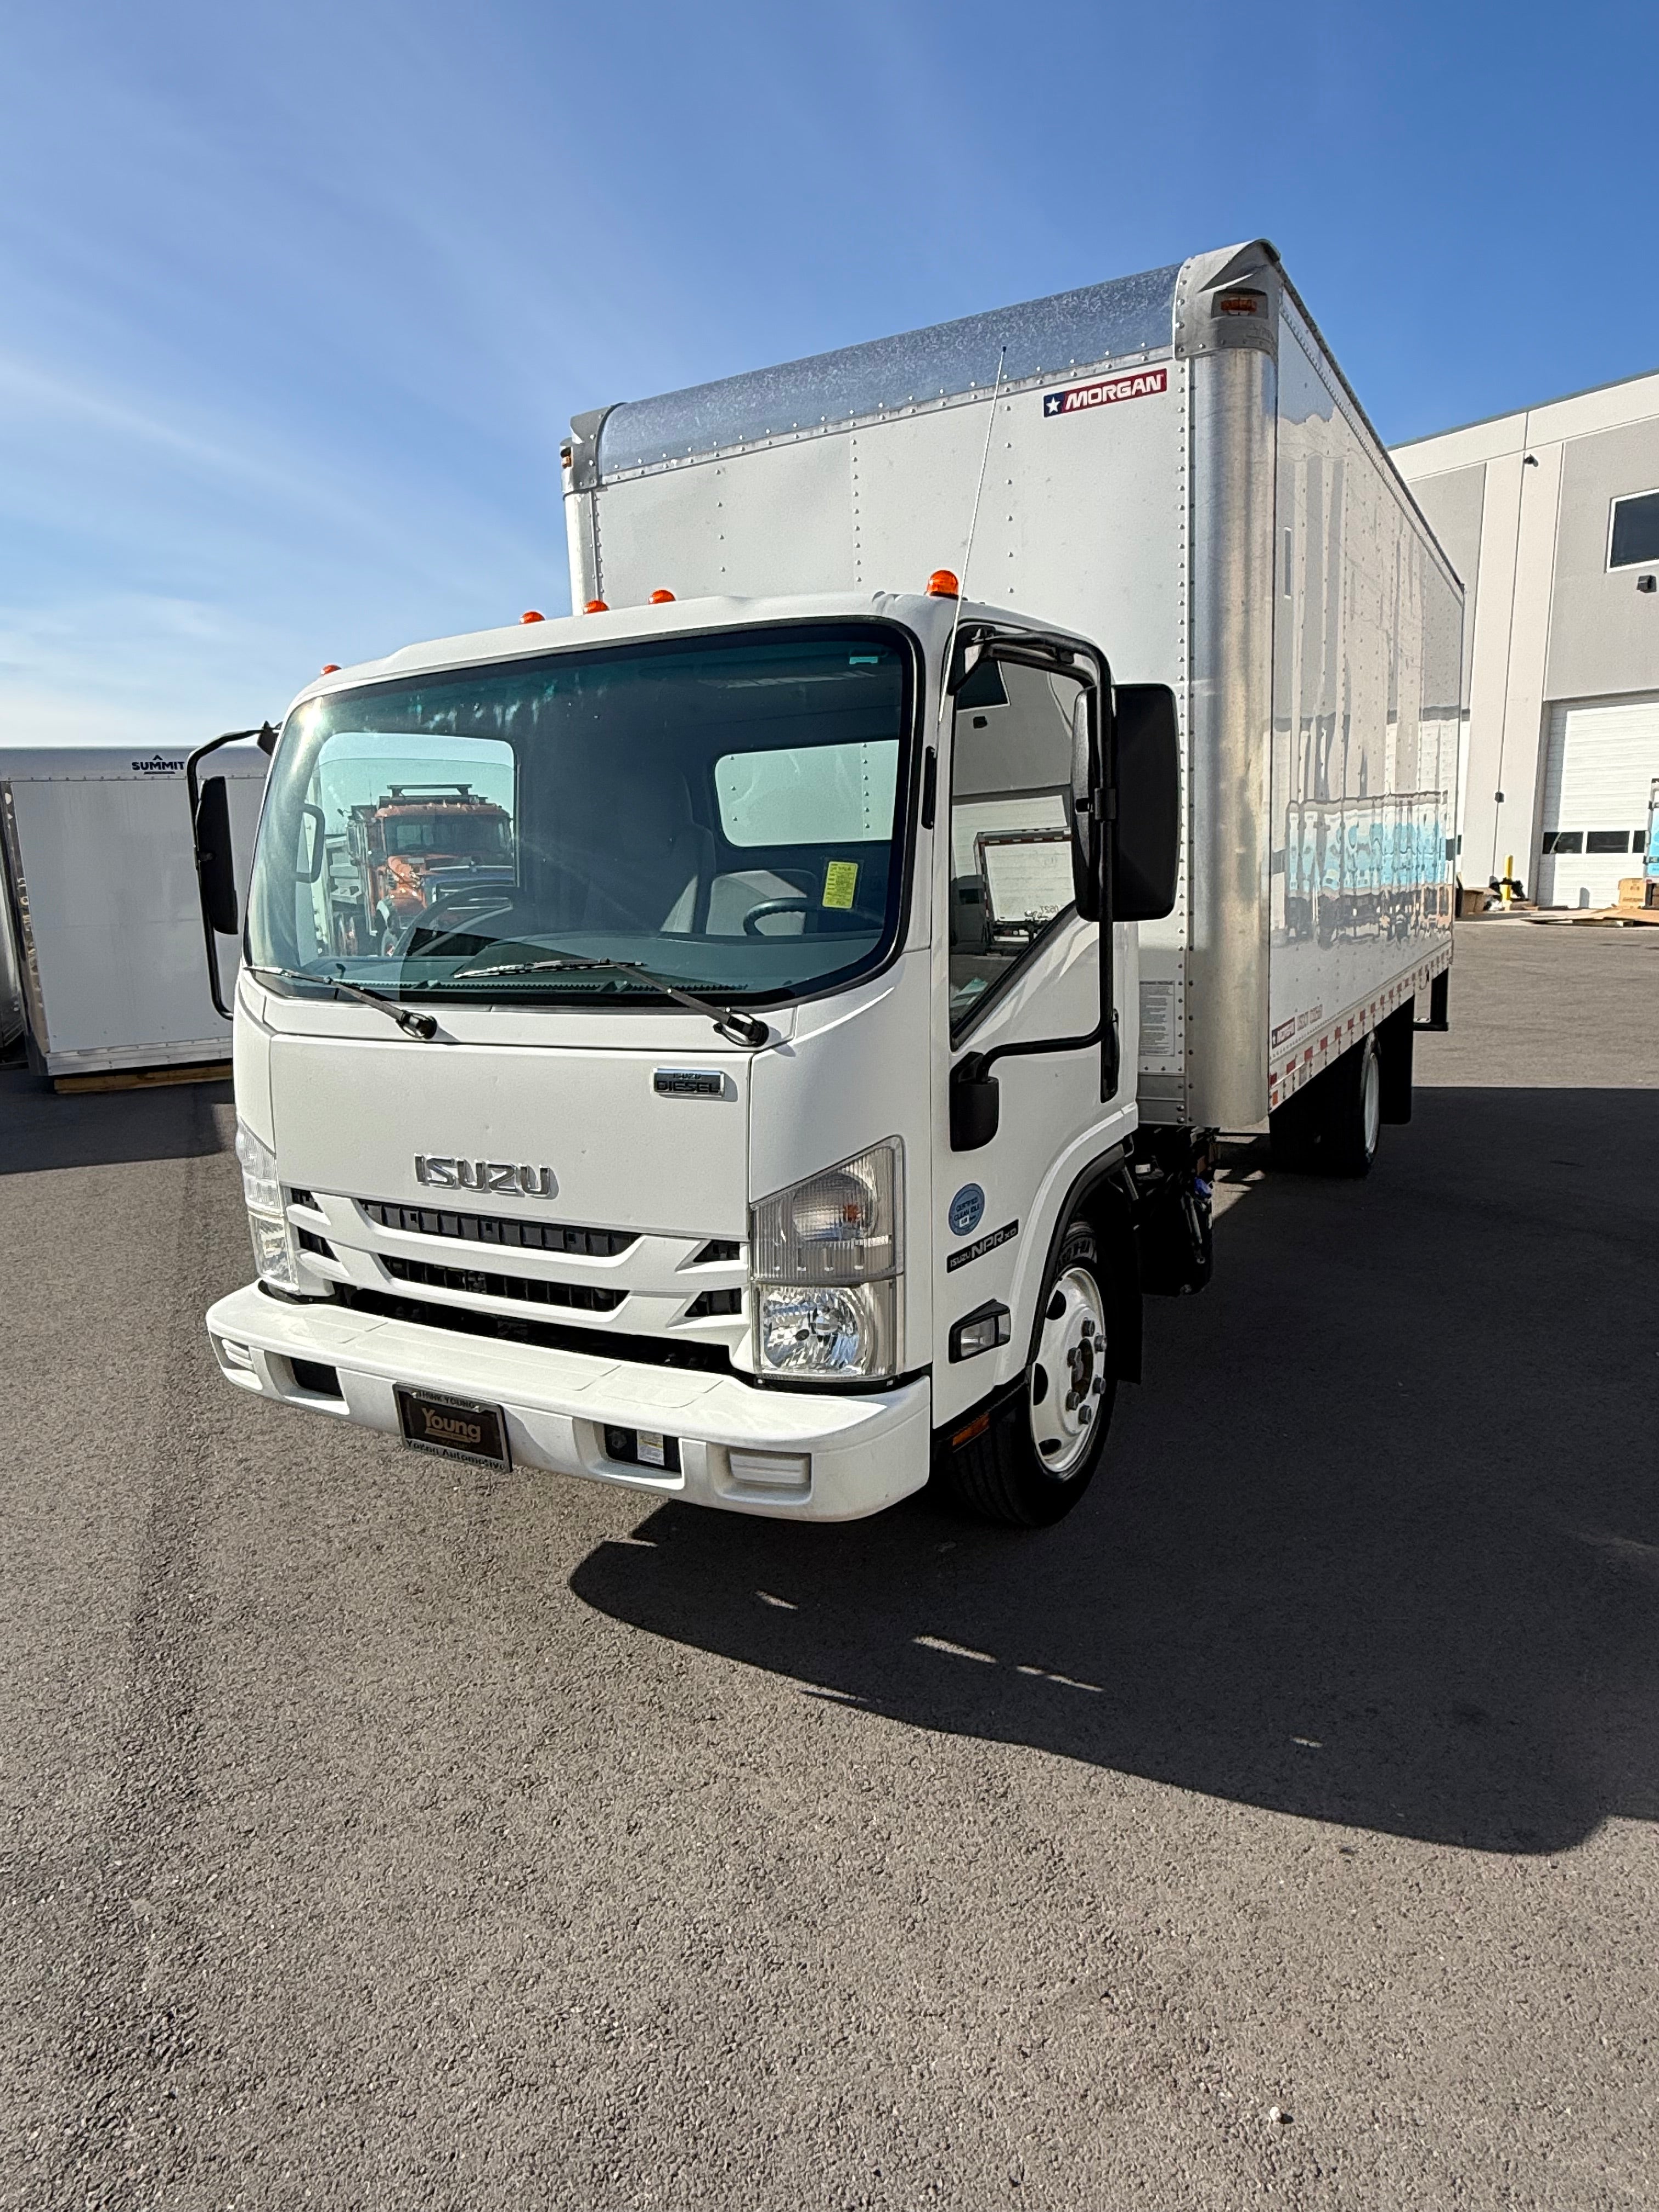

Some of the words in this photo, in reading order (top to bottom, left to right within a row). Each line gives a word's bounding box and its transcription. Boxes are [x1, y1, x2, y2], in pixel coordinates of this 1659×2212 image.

[1065, 374, 1163, 410] MORGAN
[132, 761, 185, 770] SUMMIT
[656, 1081, 721, 1093] DIESEL
[414, 1153, 551, 1195] ISUZU
[950, 1251, 971, 1267] ISUZU
[971, 1230, 1004, 1259] NPR
[421, 1408, 481, 1443] Young
